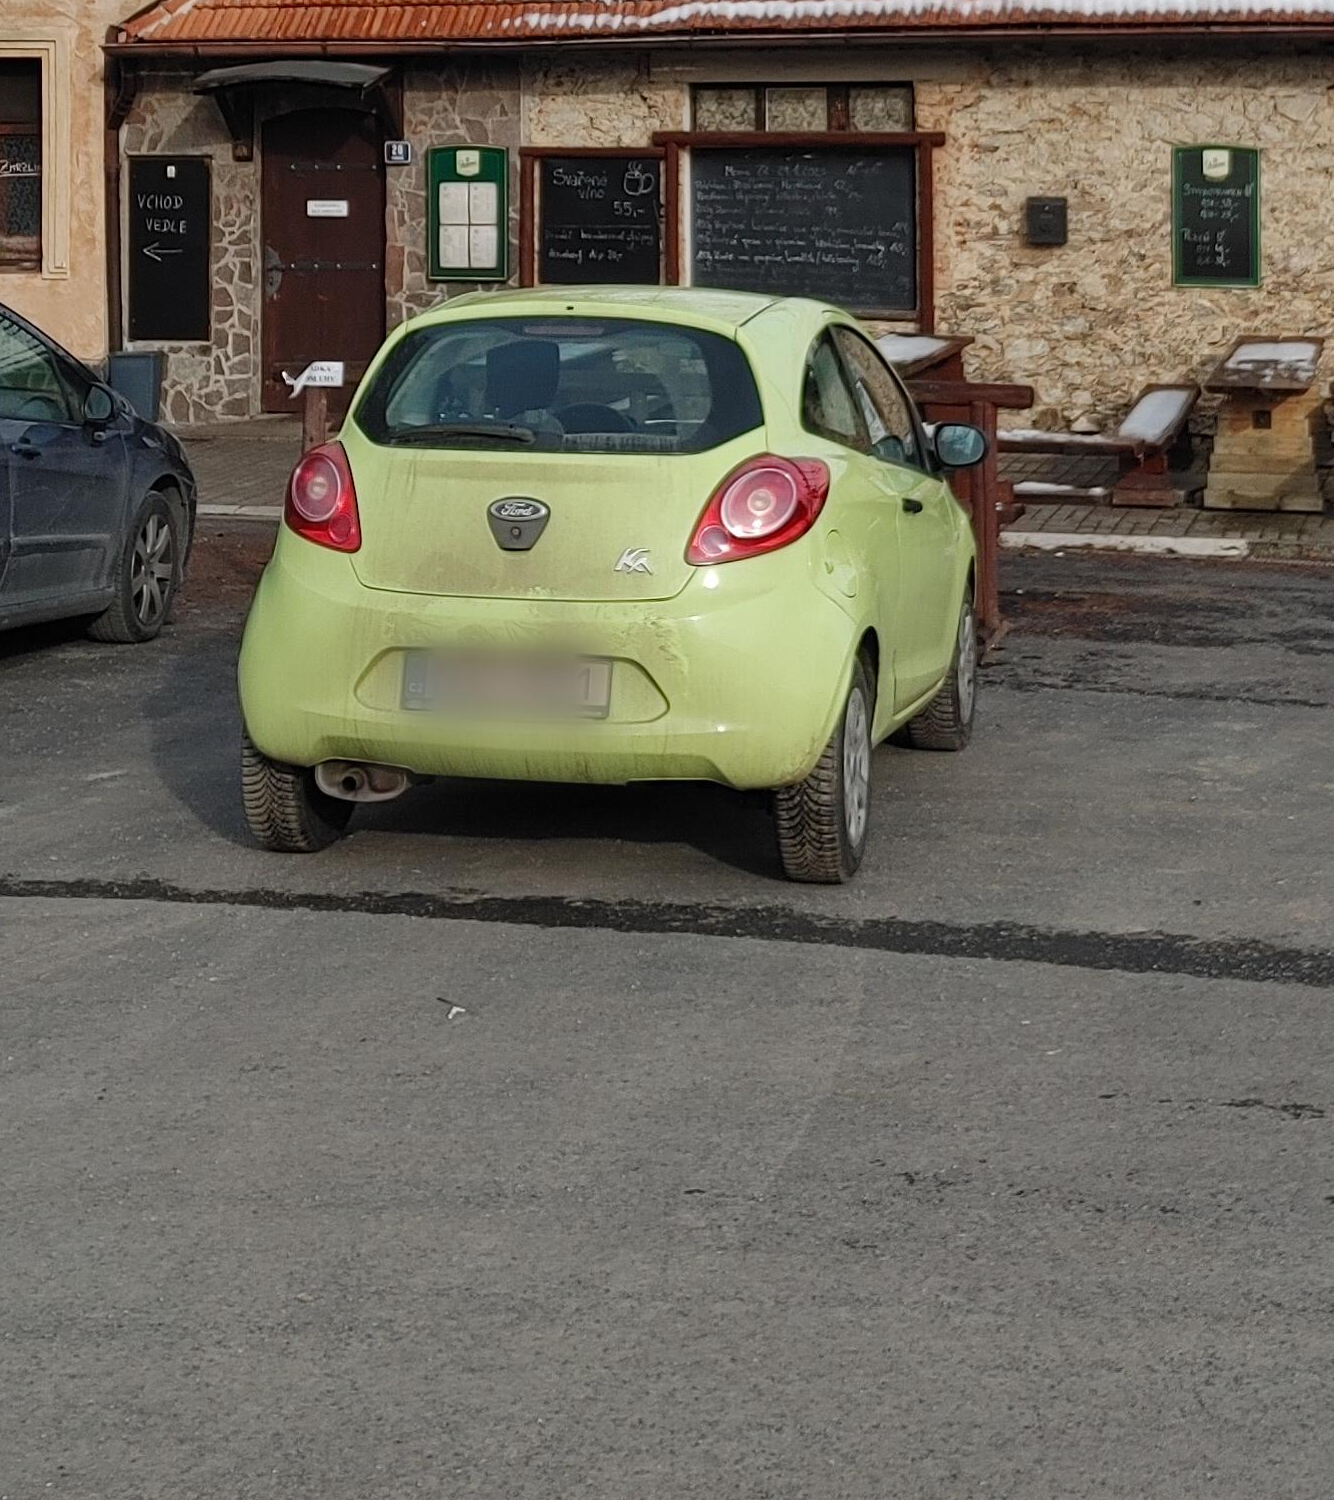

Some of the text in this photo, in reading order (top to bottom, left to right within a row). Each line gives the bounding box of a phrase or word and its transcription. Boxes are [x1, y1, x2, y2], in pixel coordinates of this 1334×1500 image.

[137, 193, 183, 209] VCHOD
[145, 218, 187, 234] VEDLE
[501, 501, 535, 516] Ford
